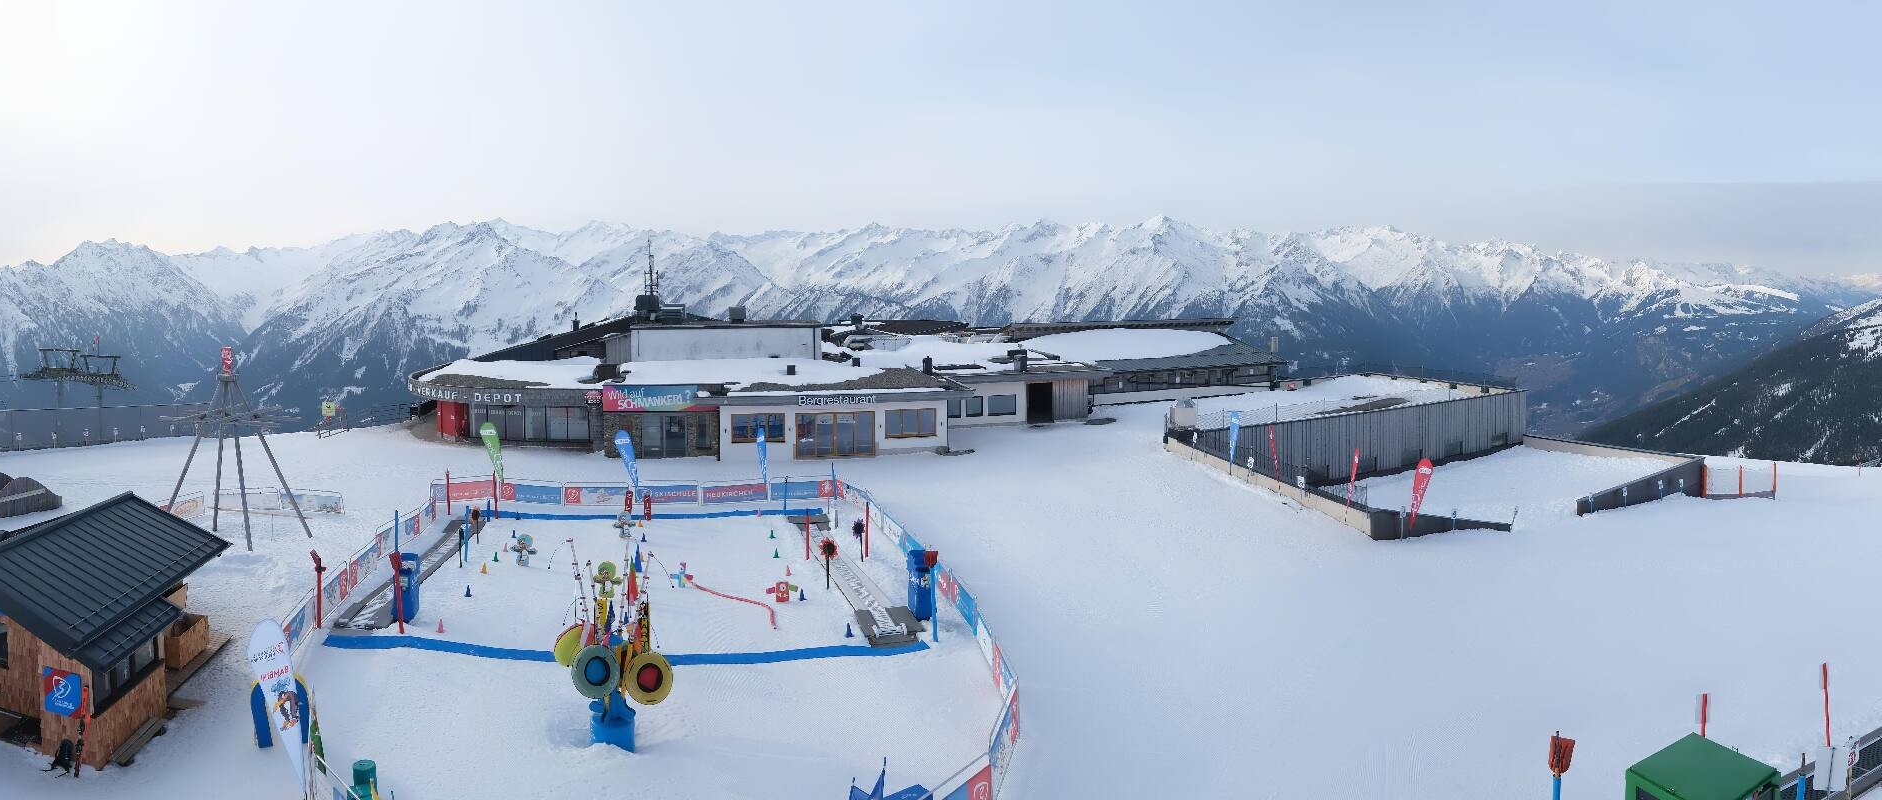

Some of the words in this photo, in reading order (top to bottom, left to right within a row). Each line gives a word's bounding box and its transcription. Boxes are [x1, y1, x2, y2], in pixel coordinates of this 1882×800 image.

[418, 386, 457, 400] VERKAUF
[474, 391, 522, 403] DEPOT
[608, 389, 628, 400] Wild
[629, 388, 645, 399] auf
[798, 395, 876, 406] Bergrestaurant
[653, 490, 697, 499] SKISCHULE
[706, 489, 754, 500] NEUKIRCHEN
